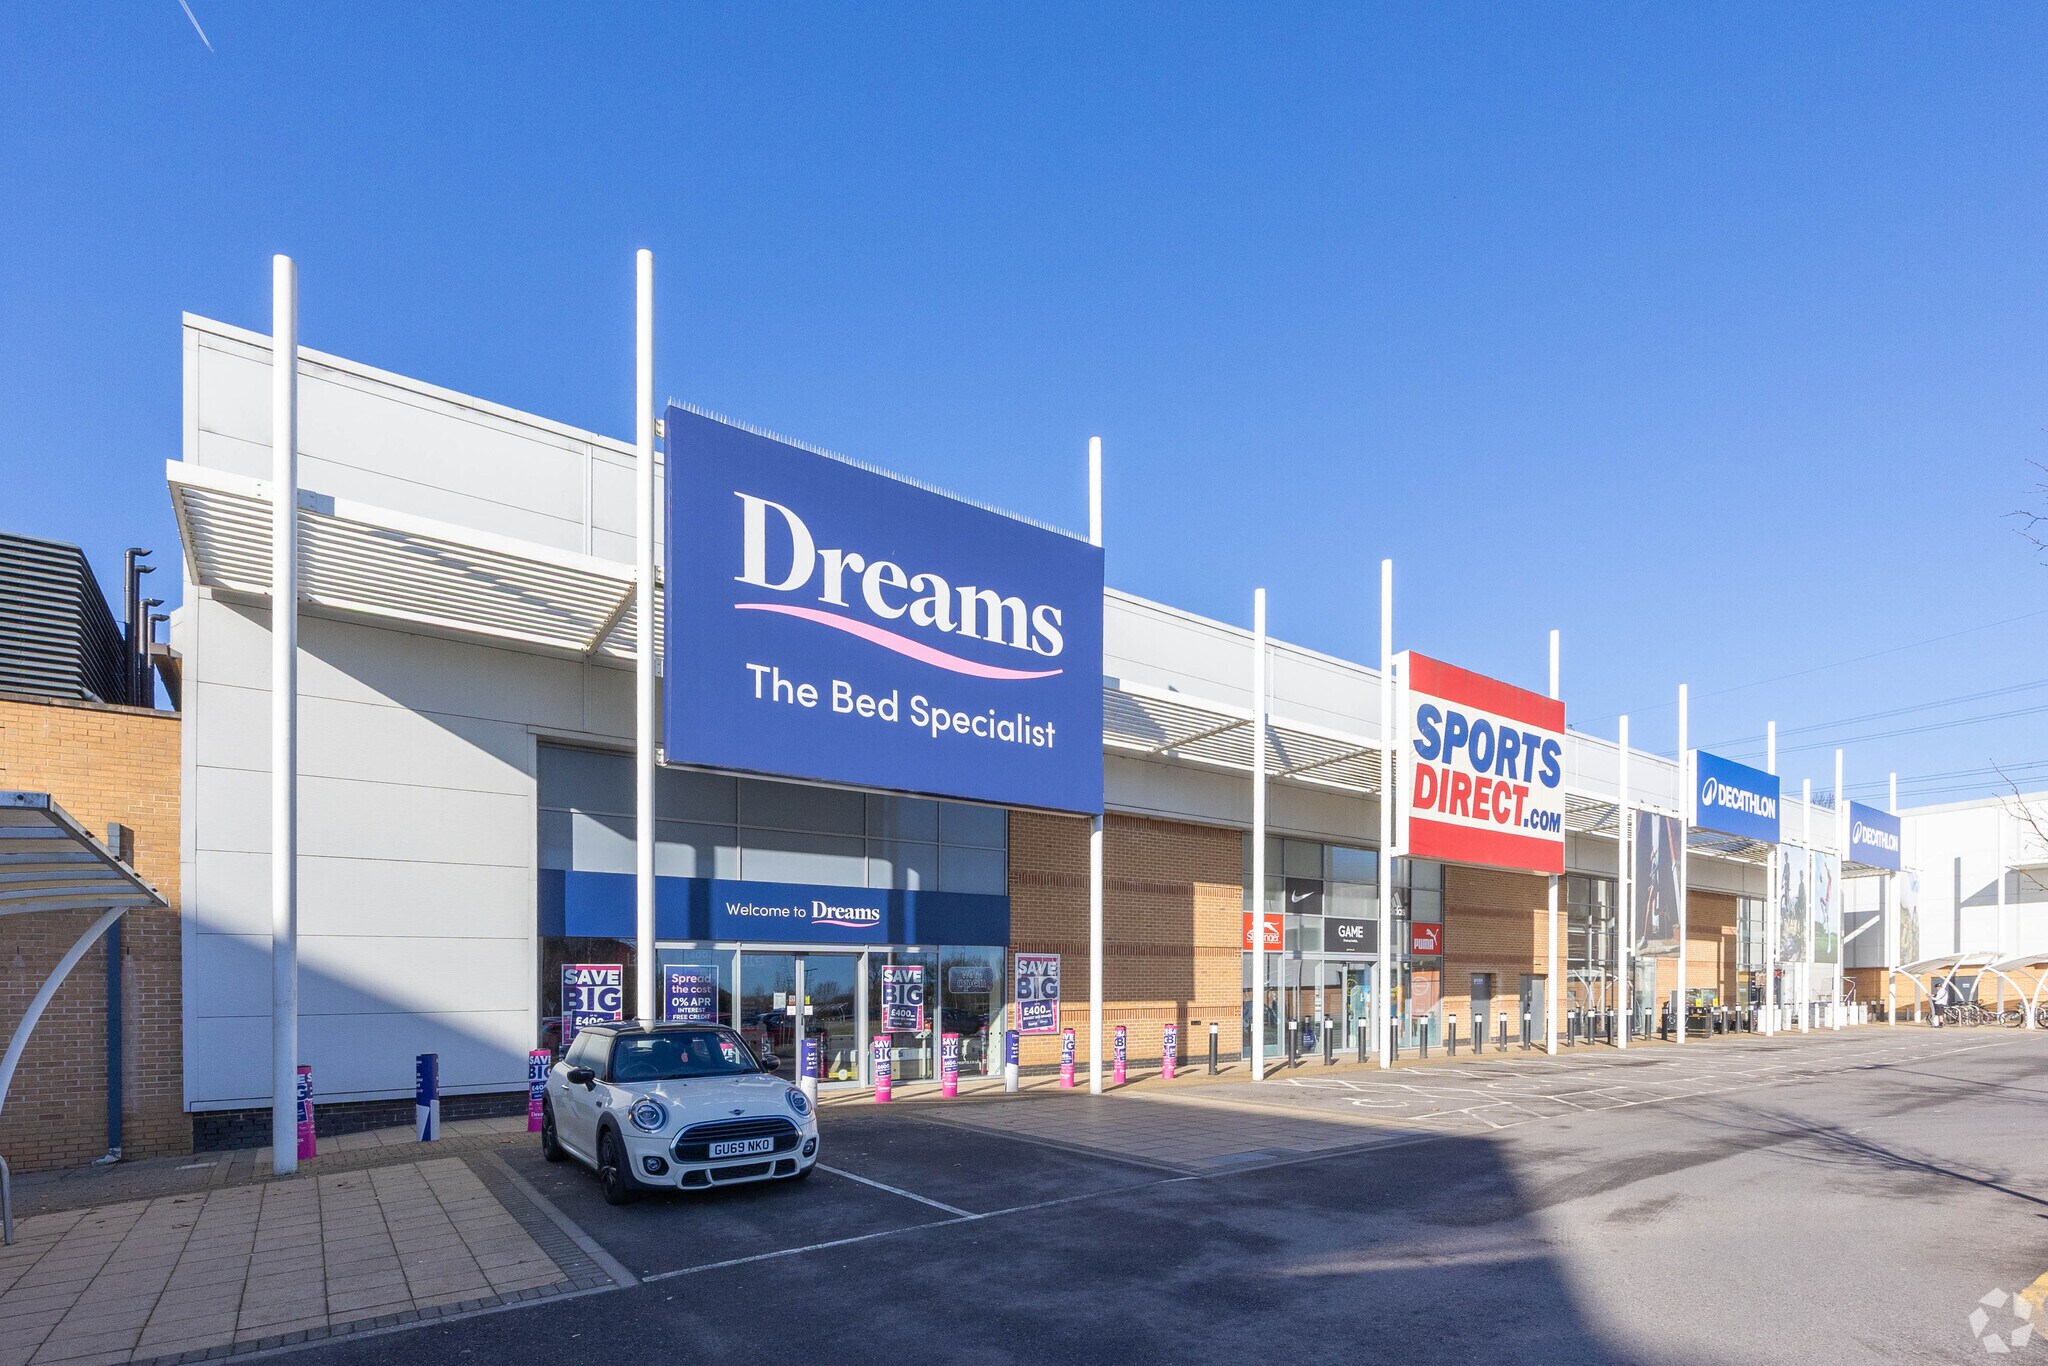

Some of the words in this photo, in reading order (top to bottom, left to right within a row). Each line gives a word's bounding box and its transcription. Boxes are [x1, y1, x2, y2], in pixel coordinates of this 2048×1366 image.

[733, 491, 1064, 658] Dreams
[746, 662, 818, 708] The
[832, 679, 899, 723] Bed
[910, 695, 1056, 749] Specialist
[1413, 703, 1562, 789] SPORTS
[1718, 783, 1776, 820] DECATHLON
[1862, 825, 1899, 852] DECATHLON
[725, 902, 790, 917] Welcome
[793, 905, 807, 918] to
[811, 900, 880, 920] Dreams
[1338, 925, 1364, 938] GAME
[1414, 938, 1434, 950] PUMA
[884, 969, 922, 983] SAVE
[1018, 960, 1057, 976] SAVE
[564, 968, 620, 985] SAVE
[671, 973, 711, 985] Spread
[671, 985, 689, 994] the
[690, 986, 712, 994] cost
[883, 984, 923, 1005] BIG
[1018, 977, 1058, 999] BIG
[563, 987, 621, 1012] BIG
[671, 997, 689, 1007] 0%
[690, 997, 711, 1006] APR
[890, 1009, 912, 1017] £400
[1023, 1005, 1046, 1016] £400
[874, 1040, 891, 1048] SAV
[942, 1038, 958, 1046] SAV
[713, 1141, 745, 1156] GU69
[747, 1139, 770, 1153] NKO
